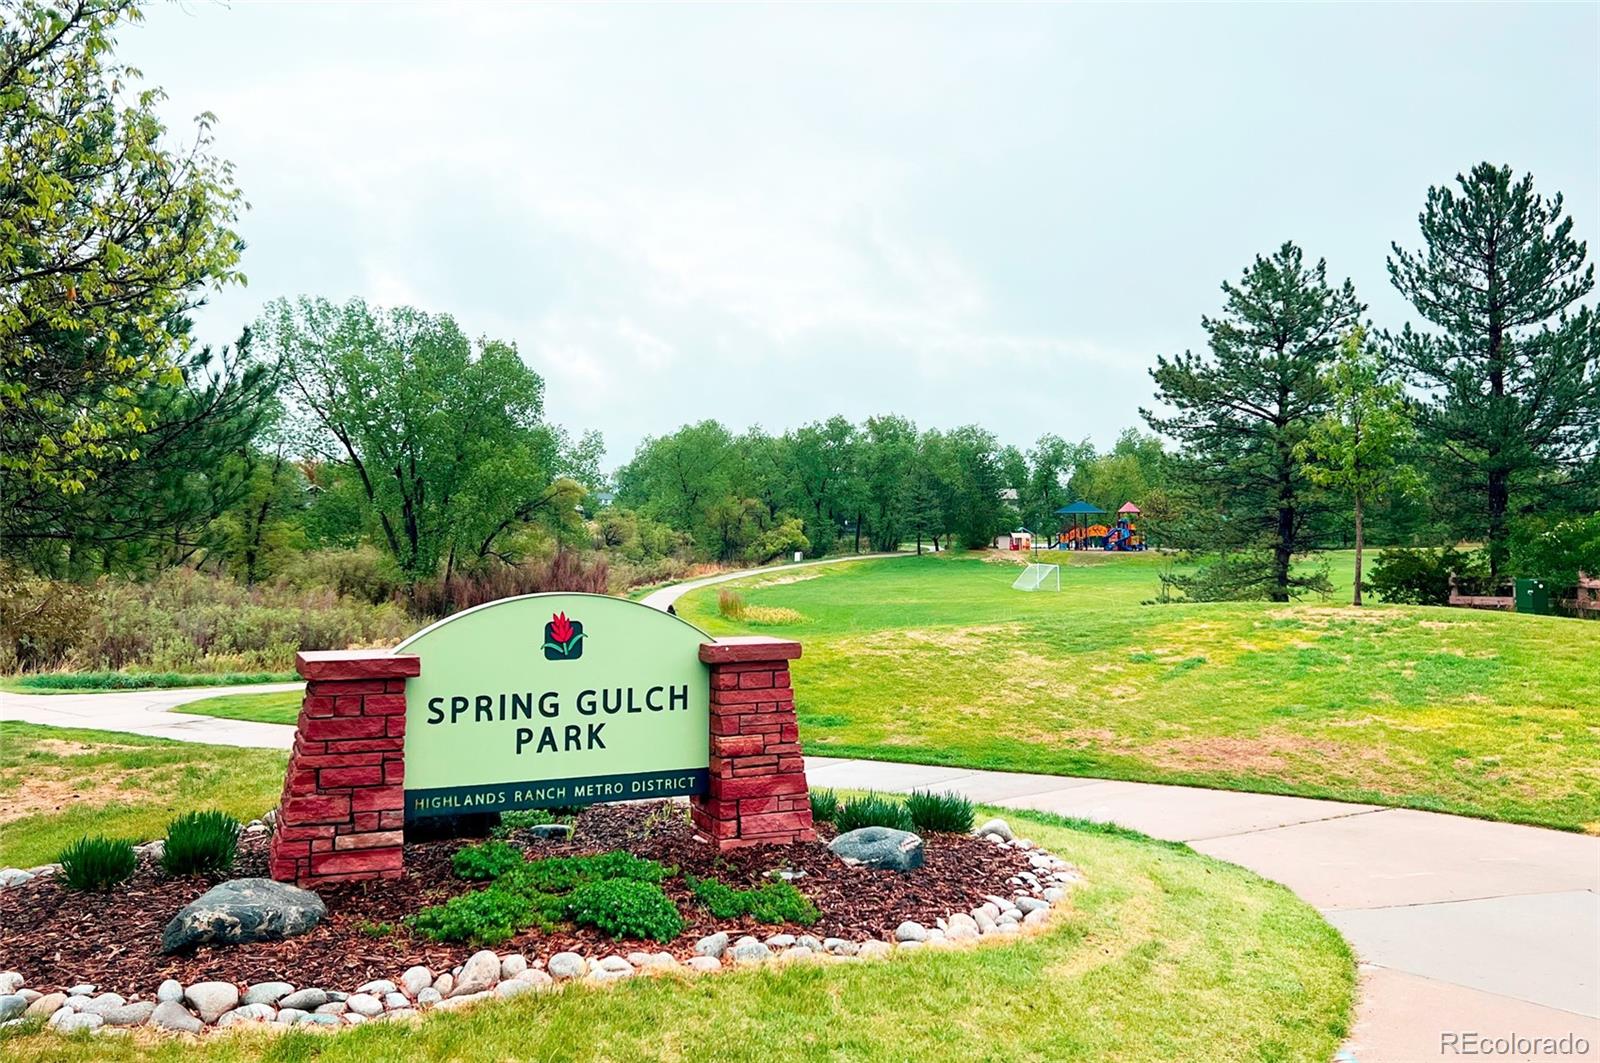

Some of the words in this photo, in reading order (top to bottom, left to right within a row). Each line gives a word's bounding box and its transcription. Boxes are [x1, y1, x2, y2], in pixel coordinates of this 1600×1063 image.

[427, 691, 559, 724] SPRING
[576, 685, 688, 715] GULCH
[516, 722, 606, 755] PARK
[414, 791, 506, 811] HIGHLANDS
[514, 787, 566, 803] RANCH
[574, 782, 624, 798] METRO
[631, 776, 696, 793] DISTRICT
